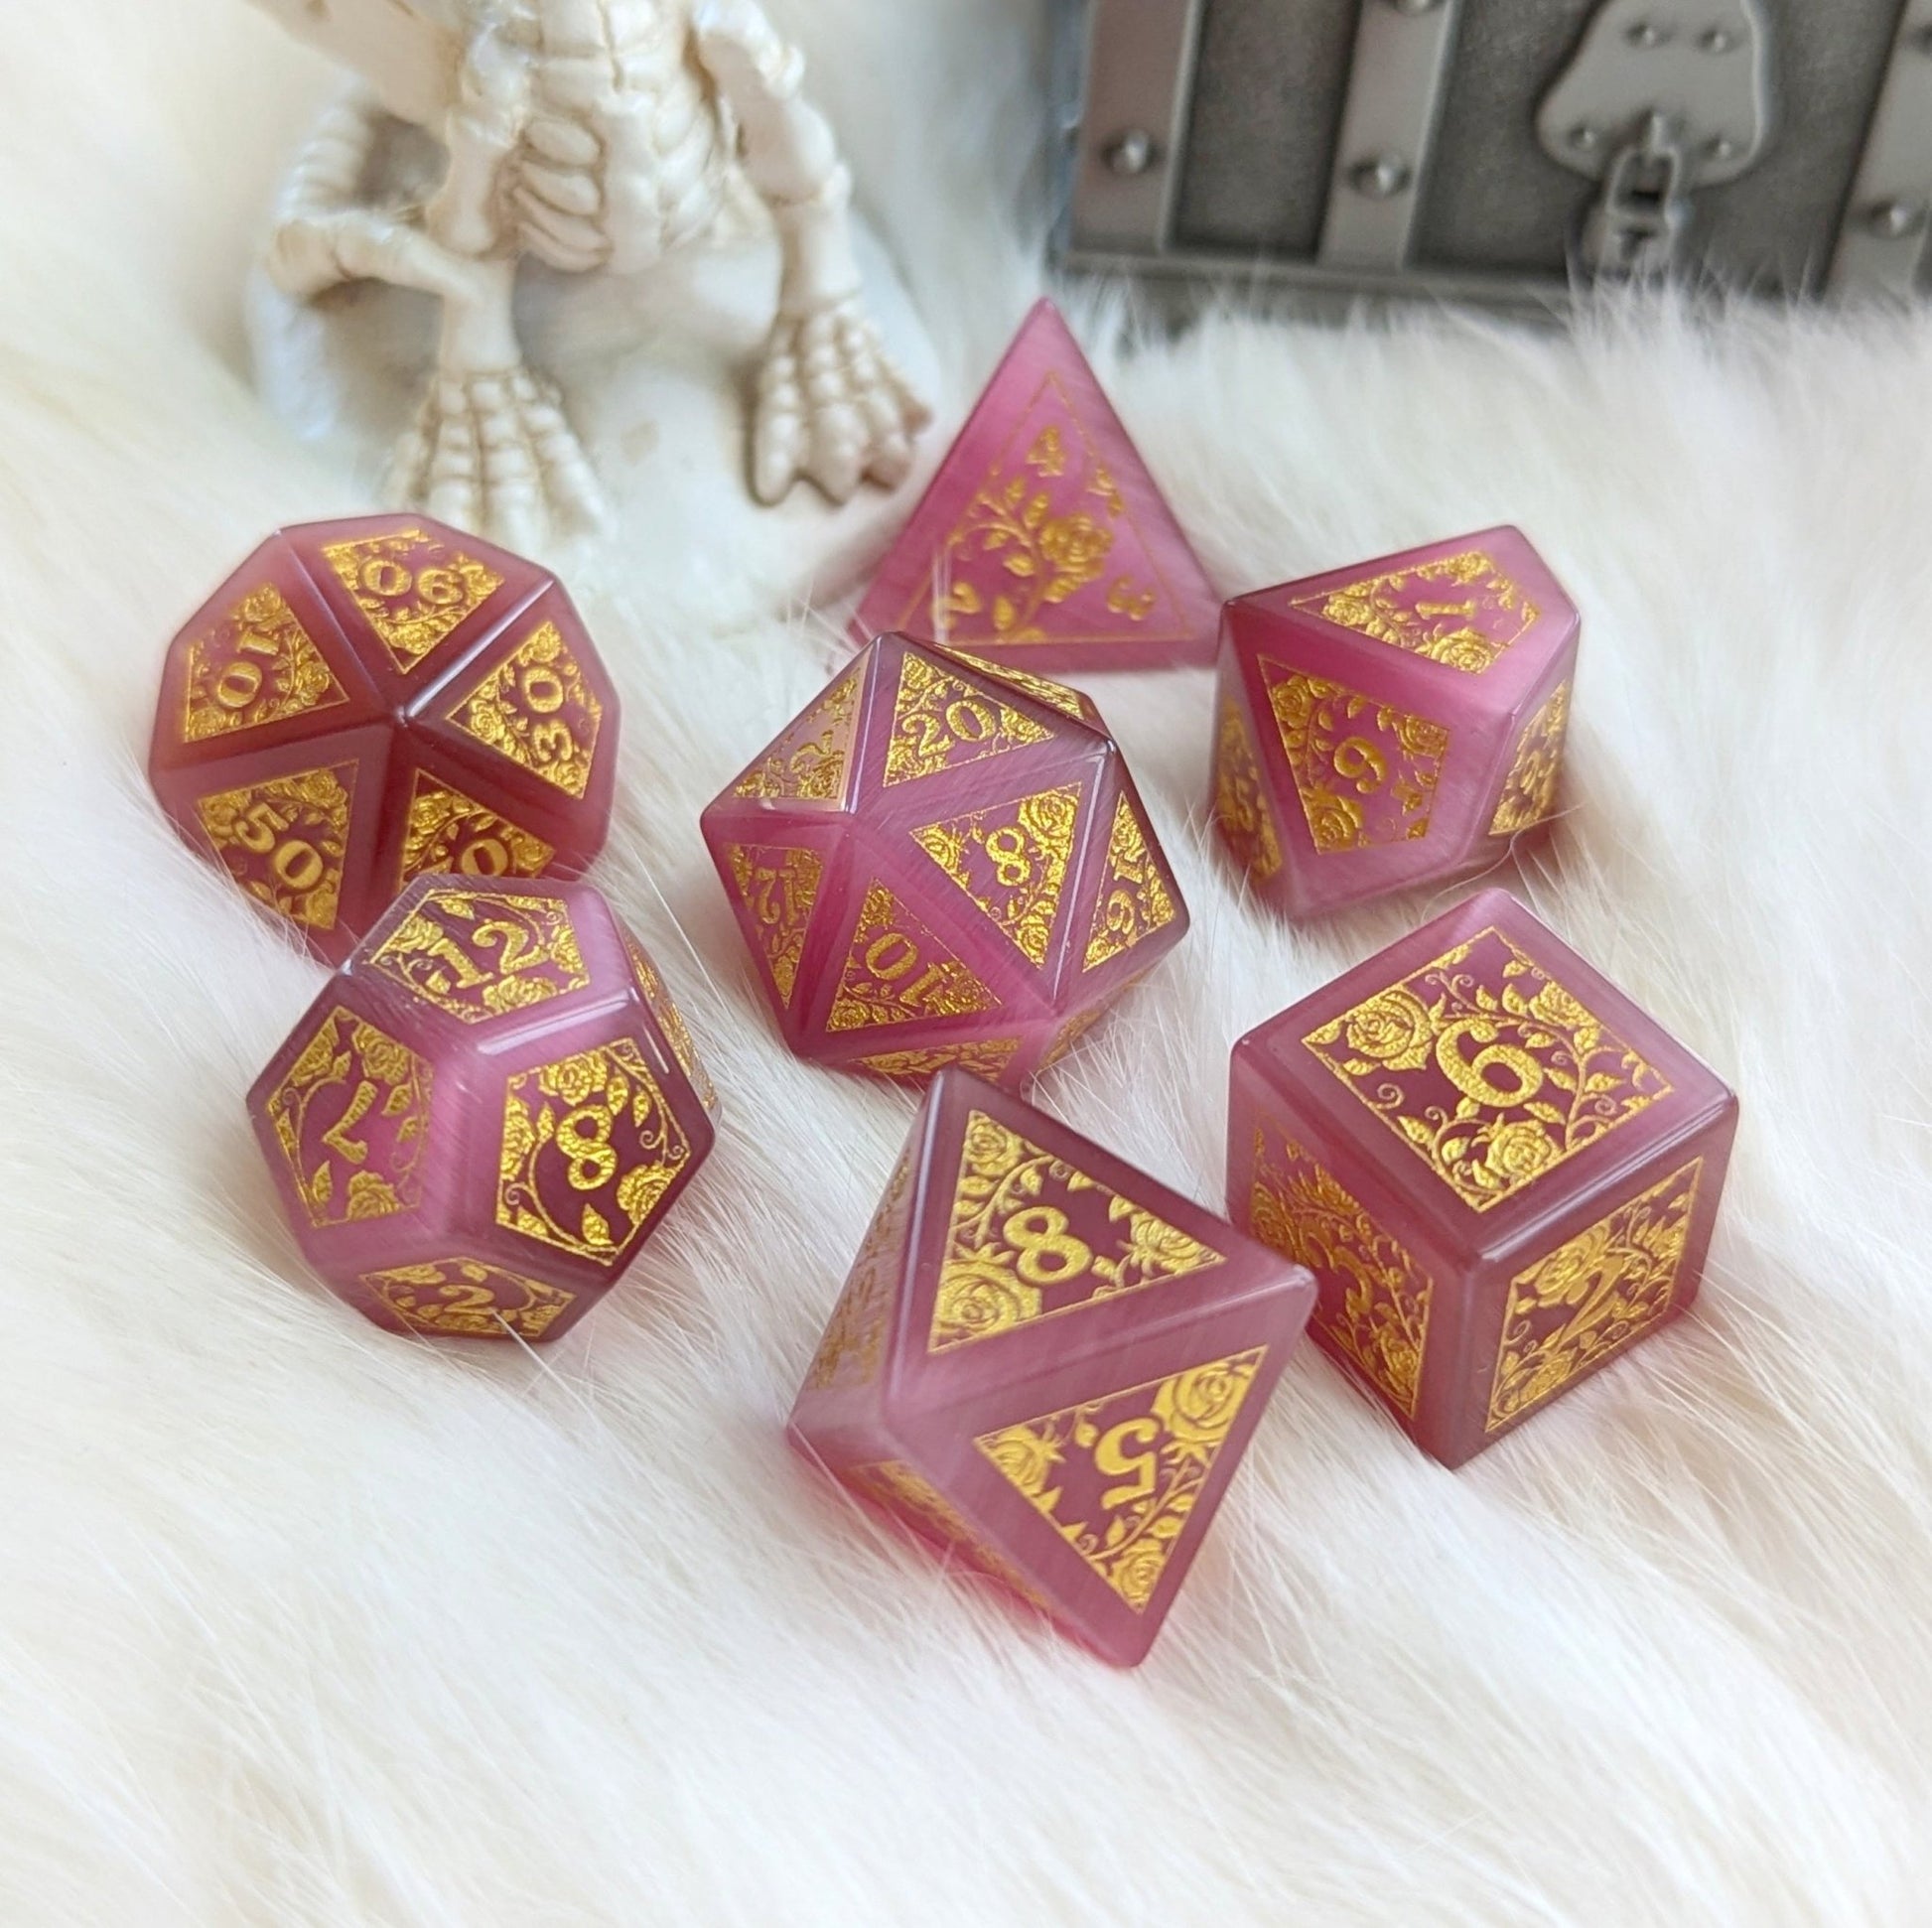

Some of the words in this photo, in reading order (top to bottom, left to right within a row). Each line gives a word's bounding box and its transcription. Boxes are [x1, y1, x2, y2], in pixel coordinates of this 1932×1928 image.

[1107, 576, 1155, 621] 3
[215, 631, 280, 709] 10
[522, 665, 573, 762] 30
[900, 699, 994, 757] 20
[233, 803, 325, 890] 50
[985, 827, 1033, 887] 8
[755, 867, 798, 926] 12
[1106, 861, 1144, 935] 16
[427, 918, 549, 989] 12
[866, 932, 949, 1008] 10
[1435, 1018, 1544, 1108] 6
[322, 1080, 377, 1164] 7
[555, 1104, 618, 1189] 8
[1003, 1206, 1091, 1285] 8
[439, 1284, 494, 1316] 2
[1557, 1255, 1624, 1350] 2
[1094, 1418, 1164, 1510] 5
